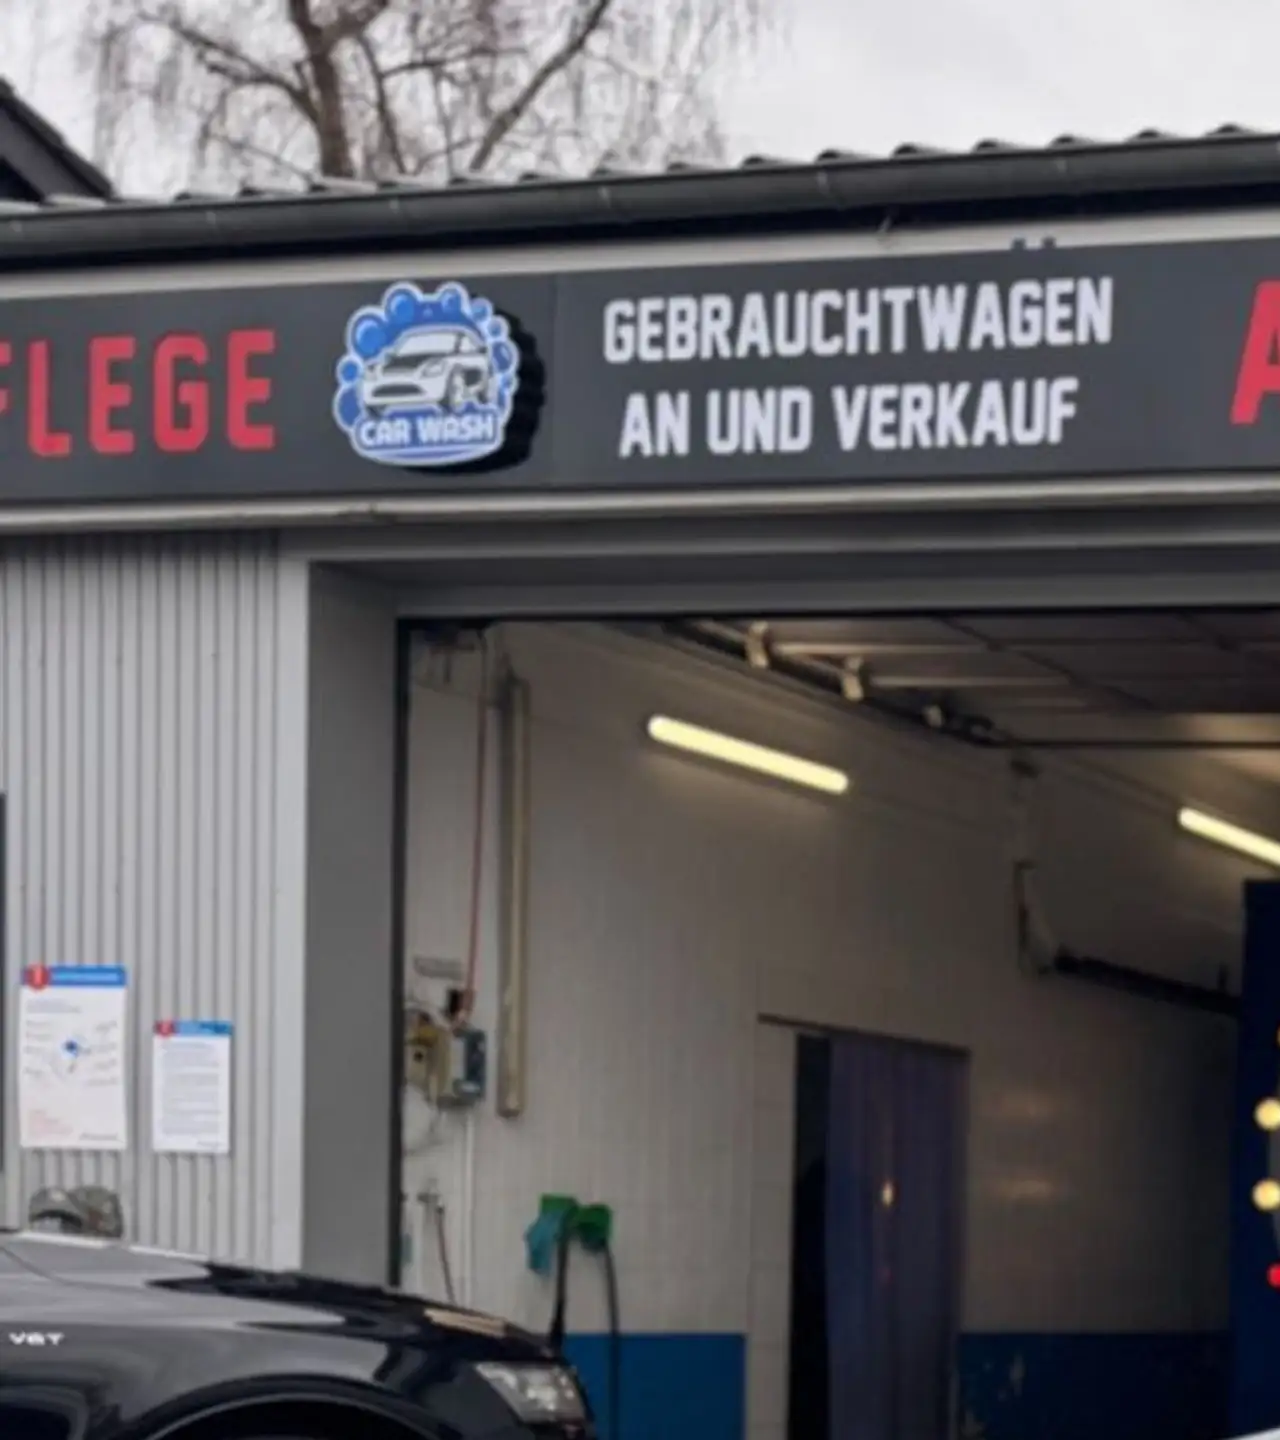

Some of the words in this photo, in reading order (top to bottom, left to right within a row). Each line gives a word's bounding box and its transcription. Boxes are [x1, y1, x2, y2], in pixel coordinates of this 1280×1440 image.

[603, 276, 1113, 363] GEBRAUCHTWAGEN
[0, 329, 275, 456] LEGE
[360, 416, 411, 446] CAR
[416, 413, 493, 443] WASH
[618, 391, 690, 458] AN
[706, 386, 813, 454] UND
[832, 376, 1080, 451] VERKAUF
